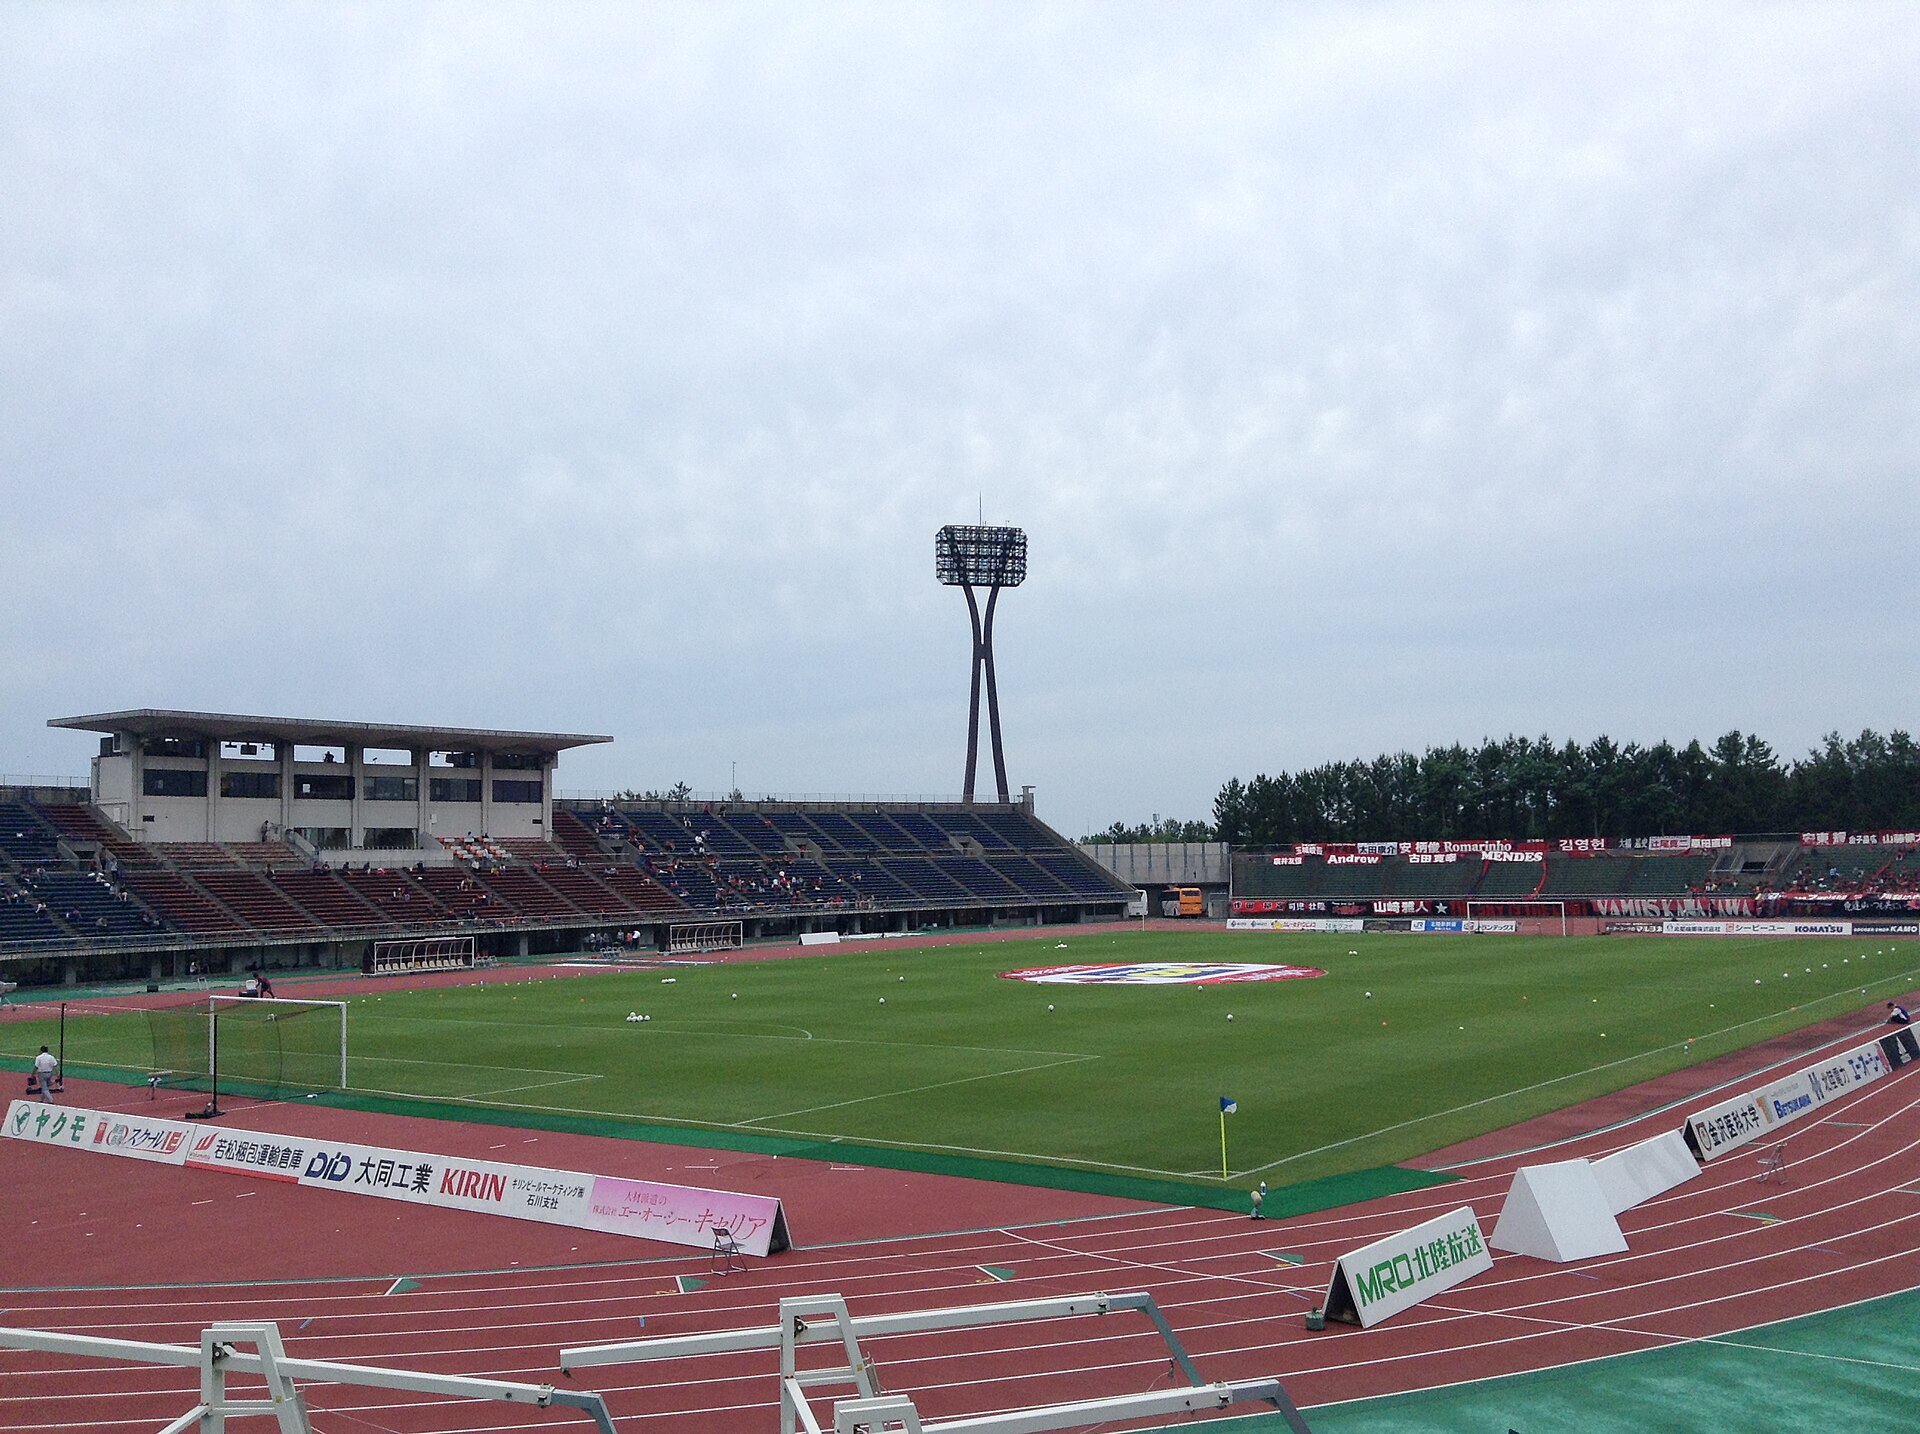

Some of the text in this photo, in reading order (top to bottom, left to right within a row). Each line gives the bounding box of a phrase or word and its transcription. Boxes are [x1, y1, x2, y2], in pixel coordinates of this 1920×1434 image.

[1443, 840, 1512, 853] Romarinho
[1327, 854, 1379, 864] Andrew
[1481, 851, 1543, 862] MENDES
[1794, 924, 1843, 933] KOMATSU
[1890, 925, 1918, 933] KAMO
[35, 1108, 86, 1142] ヤクモ
[1708, 1103, 1760, 1147] 金沢医科大学
[214, 1138, 304, 1170] 若松梱包運輸倉庫
[354, 1156, 433, 1194] 大同工業
[440, 1168, 507, 1202] KIRIN
[526, 1194, 559, 1210] 石川支社
